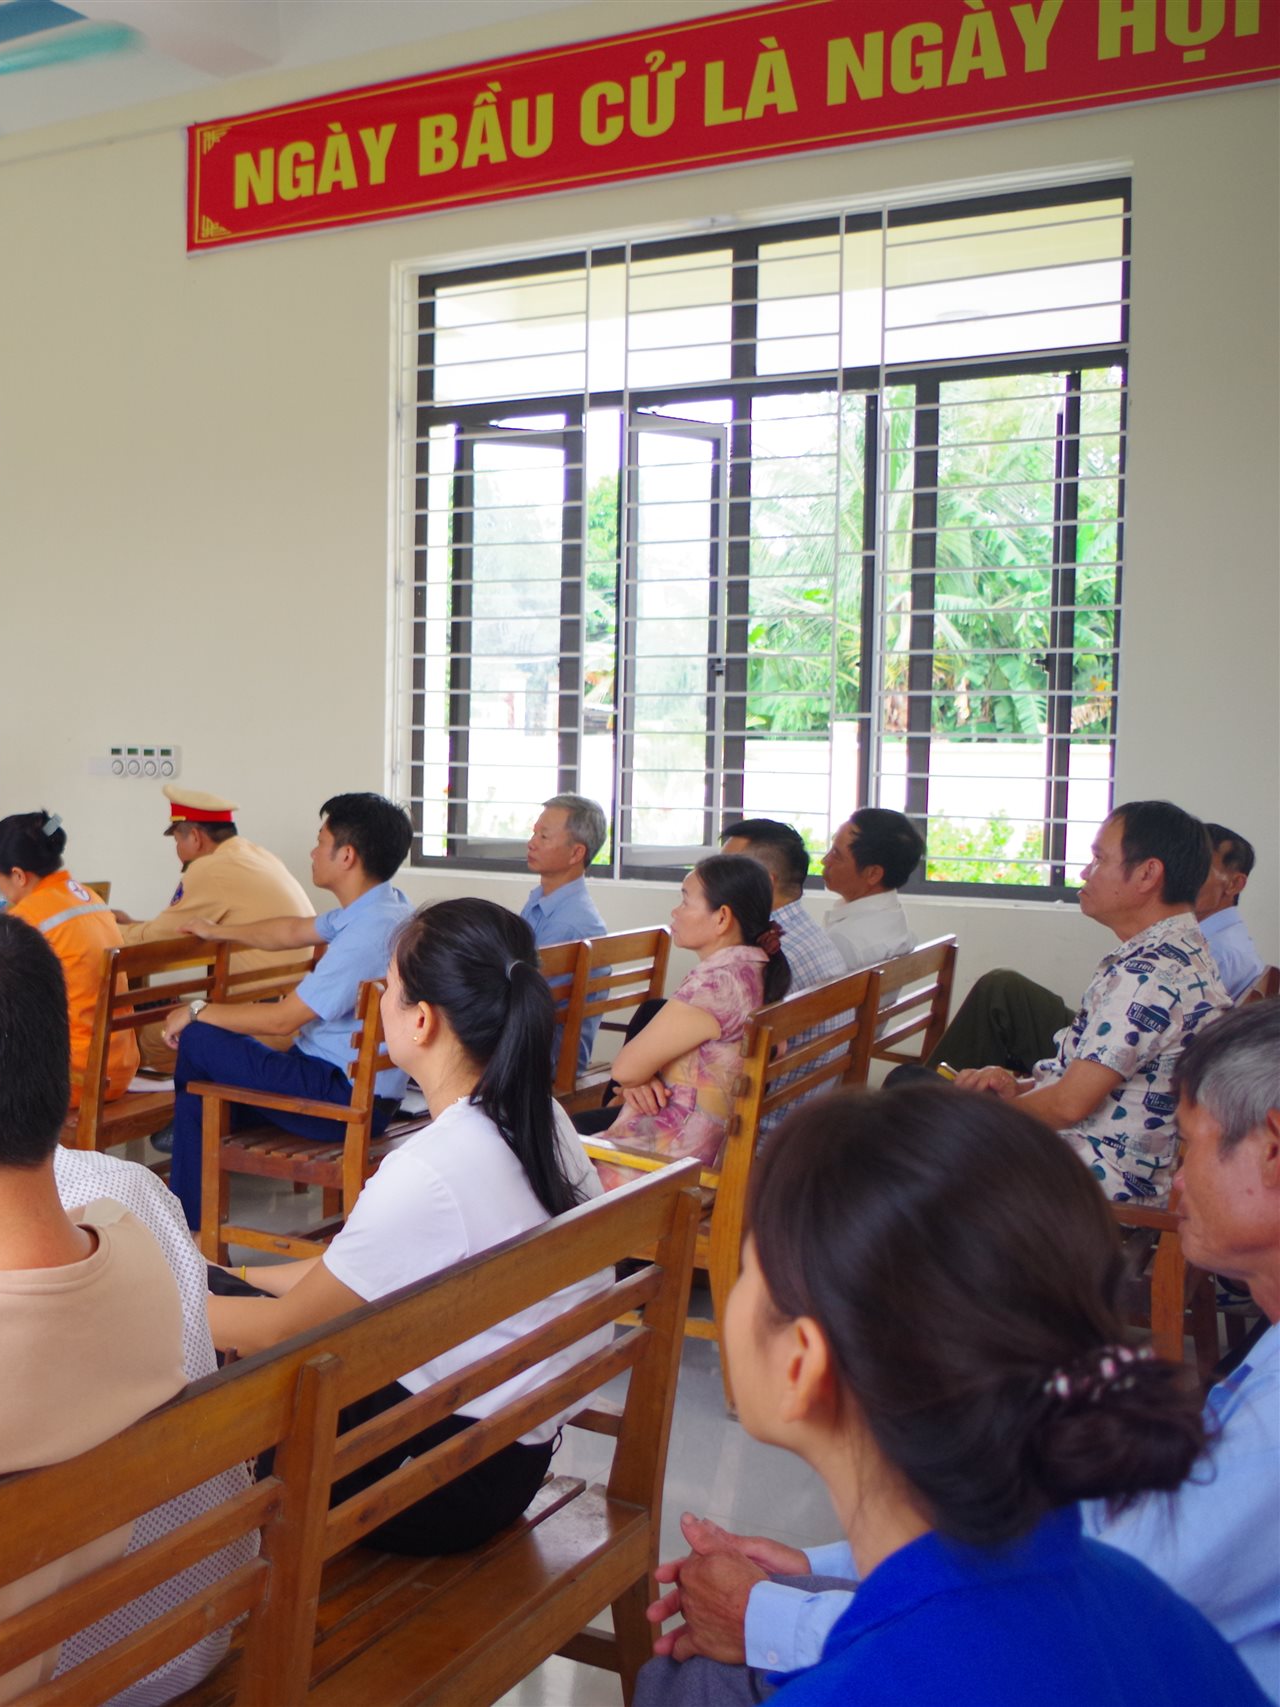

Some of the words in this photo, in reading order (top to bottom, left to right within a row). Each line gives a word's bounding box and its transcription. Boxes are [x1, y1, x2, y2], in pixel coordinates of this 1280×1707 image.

[233, 122, 398, 210] NGÀY
[417, 80, 555, 178] BẦU
[578, 49, 688, 147] CỬ
[703, 36, 799, 128] LÀ
[826, 0, 1064, 107] NGÀY
